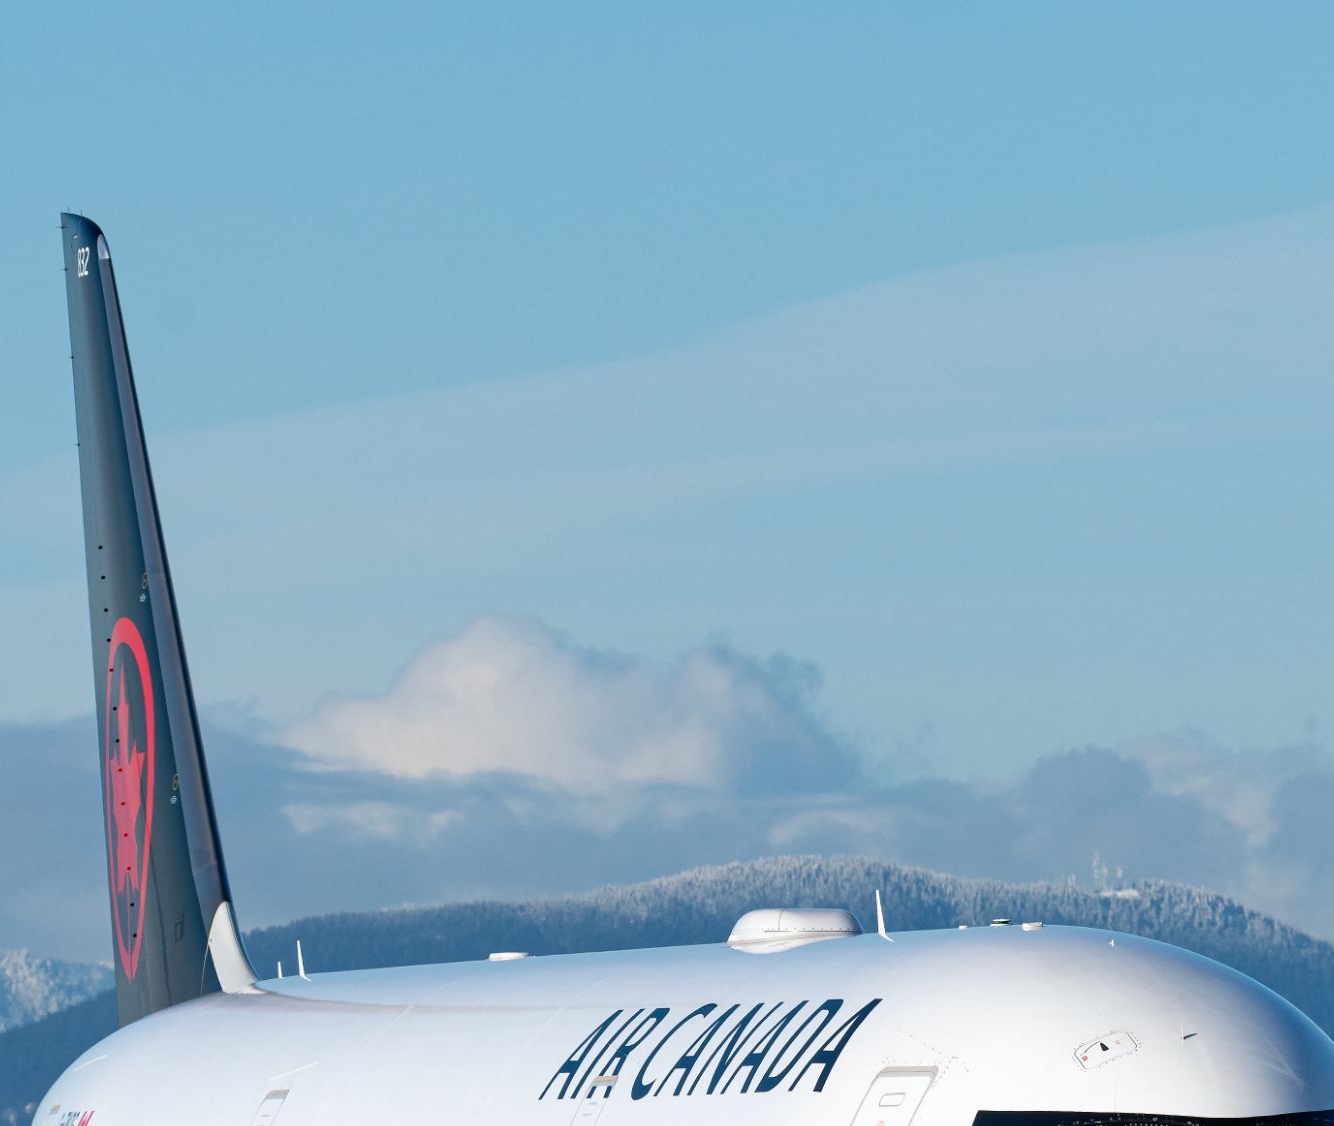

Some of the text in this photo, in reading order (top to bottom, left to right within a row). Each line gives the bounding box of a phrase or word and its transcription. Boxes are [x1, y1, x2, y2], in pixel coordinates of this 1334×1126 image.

[77, 246, 90, 278] 832
[538, 998, 883, 1101] AIR CANADA
